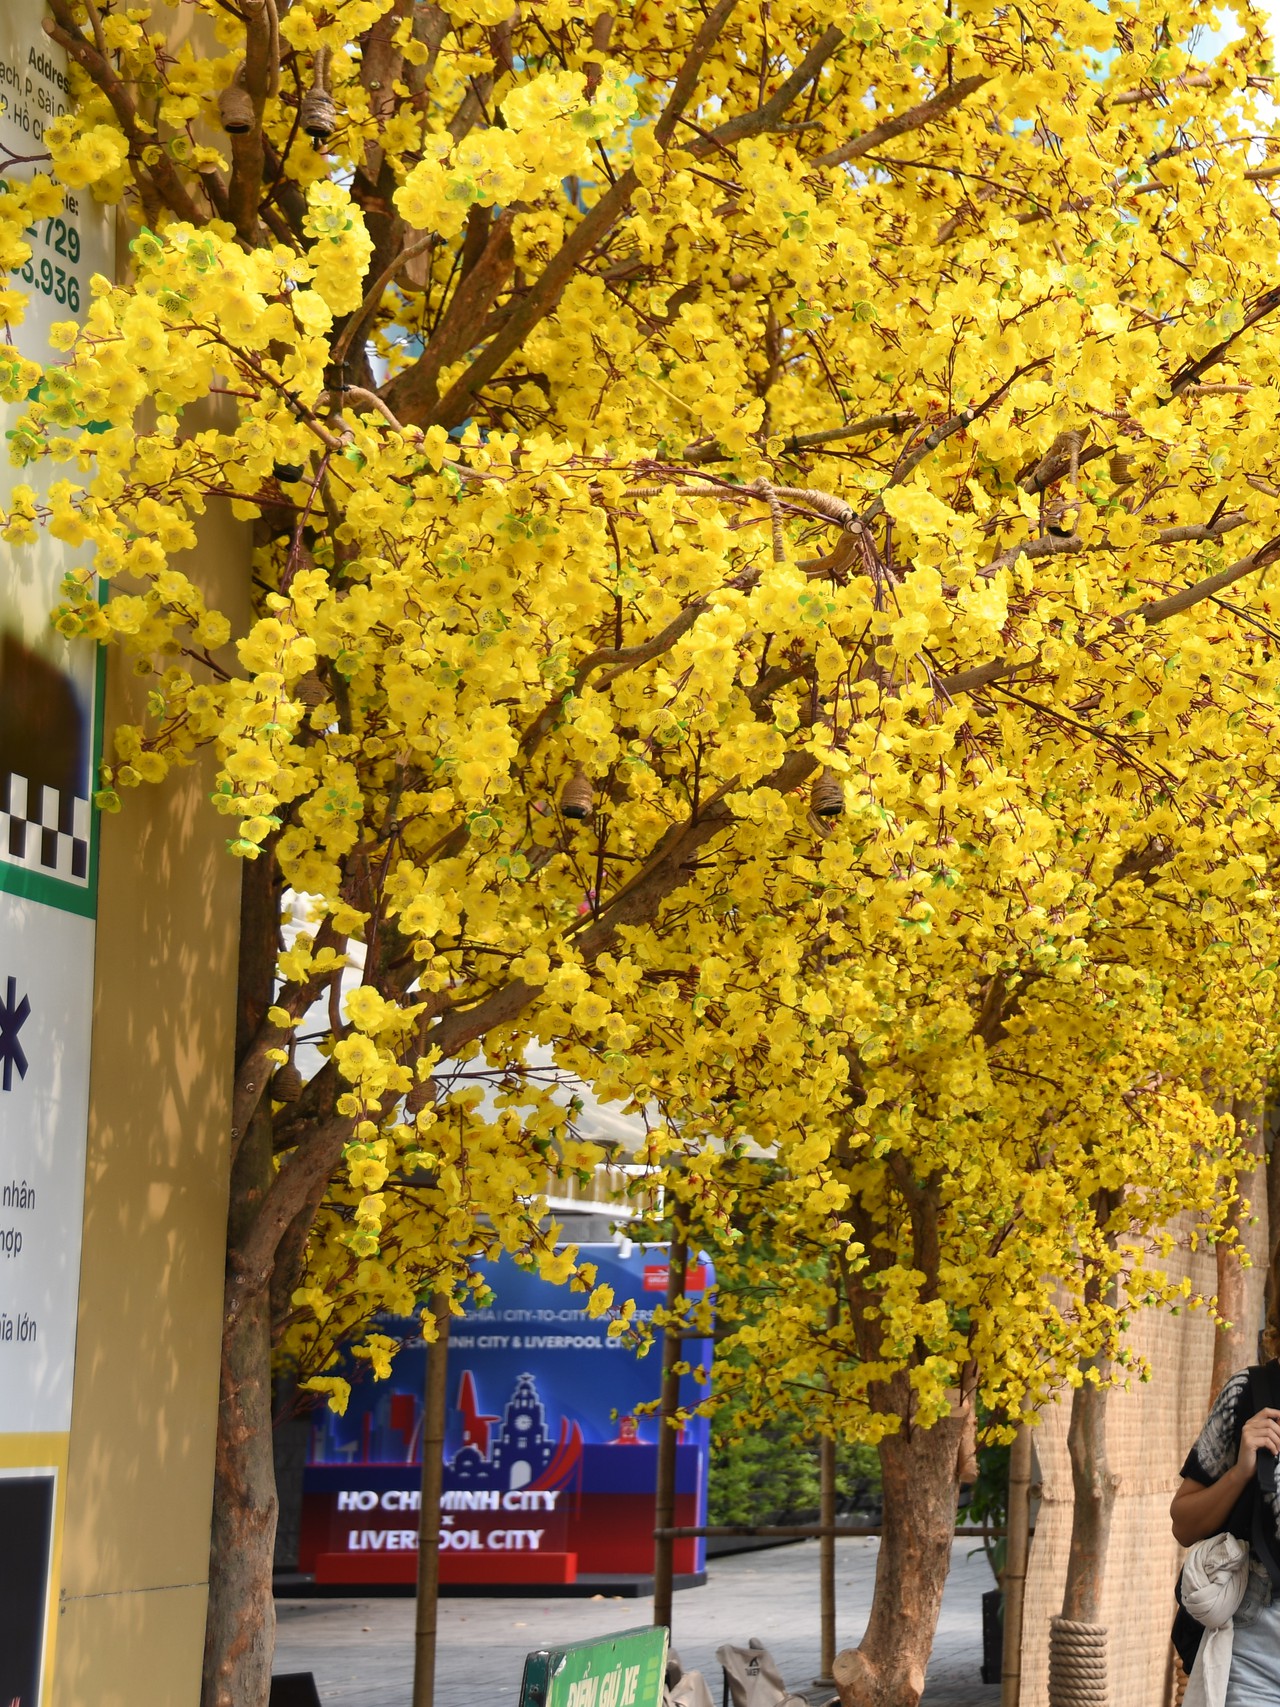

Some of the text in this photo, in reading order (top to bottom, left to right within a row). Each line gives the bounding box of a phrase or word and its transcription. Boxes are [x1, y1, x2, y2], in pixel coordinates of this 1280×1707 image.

[28, 46, 72, 95] Addres
[14, 101, 30, 132] Hồ
[38, 87, 55, 117] Sài
[3, 1180, 36, 1210] nhân
[16, 1312, 37, 1342] lớn
[477, 1335, 510, 1348] CITY
[512, 1336, 521, 1348] &
[525, 1335, 603, 1348] LIVERPOOL
[338, 1490, 379, 1511] HO
[440, 1490, 500, 1511] MINH
[502, 1490, 560, 1511] CITY
[348, 1528, 545, 1550] LIVEROOL CITY
[620, 1664, 640, 1707] XE
